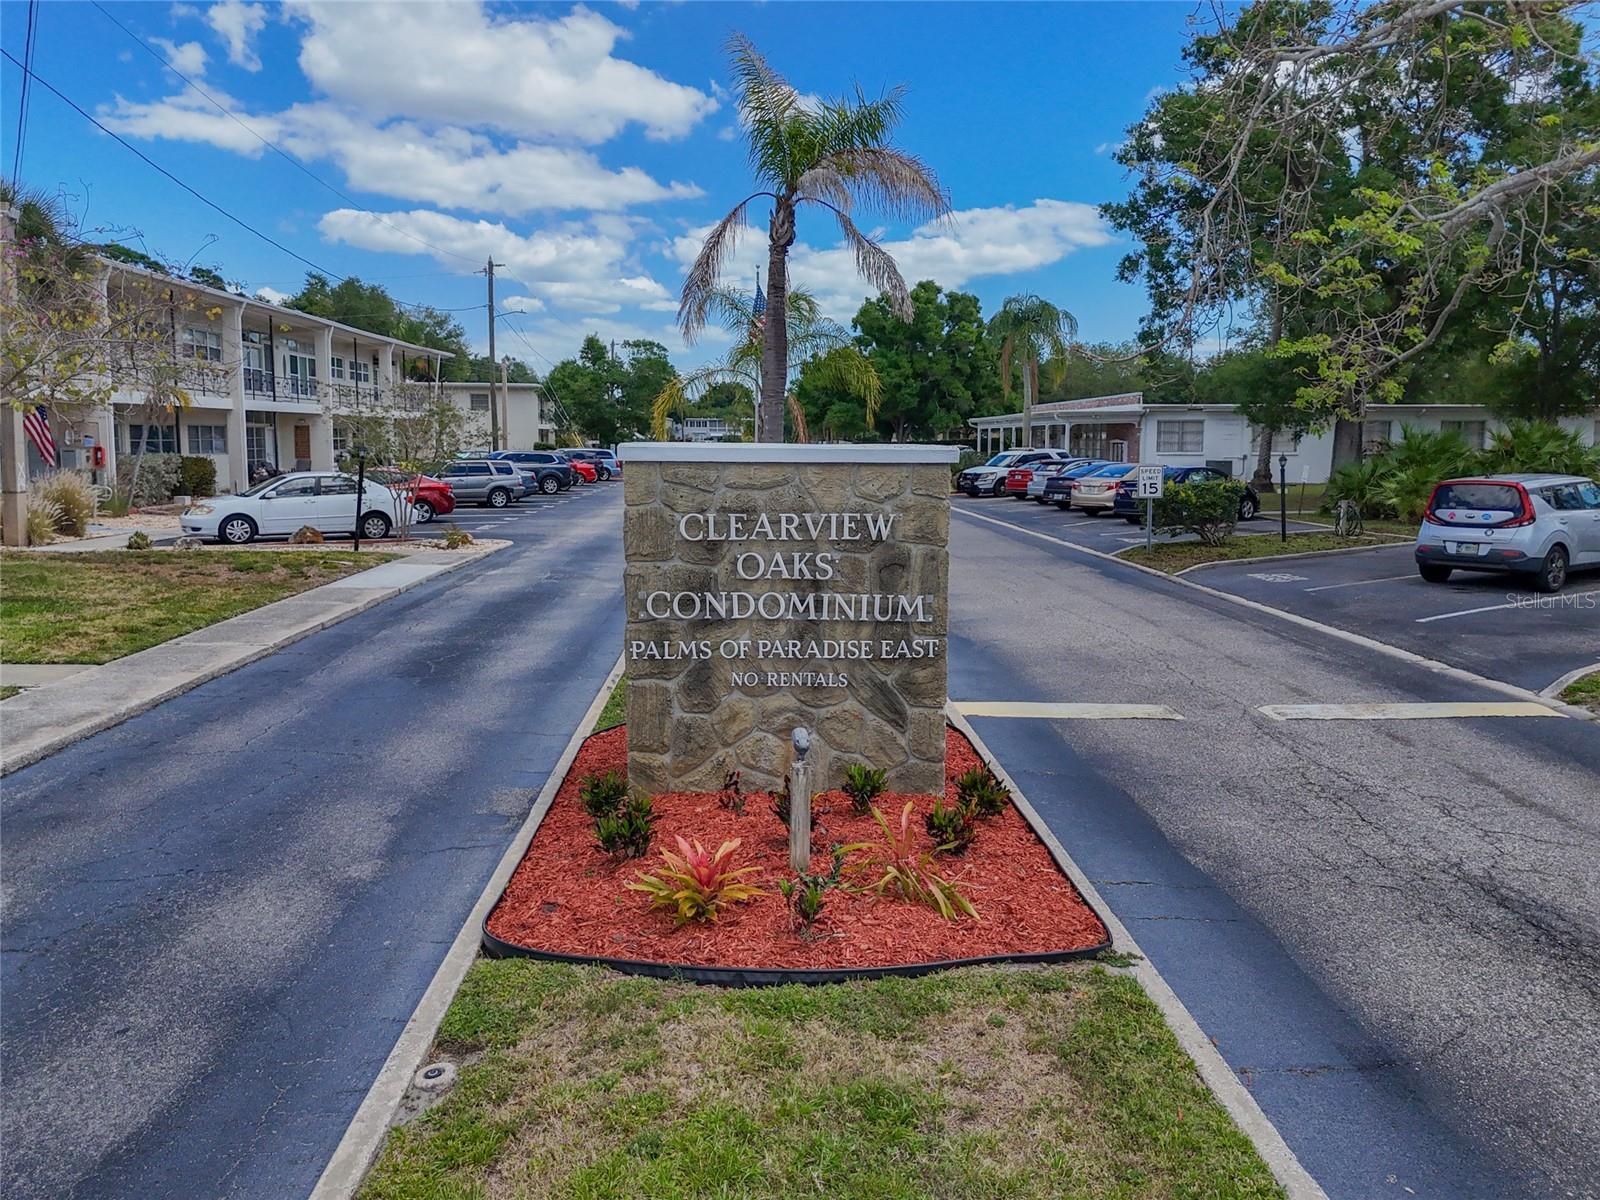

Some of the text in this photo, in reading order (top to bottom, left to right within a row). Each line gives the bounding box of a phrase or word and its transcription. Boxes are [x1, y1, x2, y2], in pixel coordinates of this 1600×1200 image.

[1142, 482, 1159, 495] 15
[679, 513, 895, 542] CLEARVIEW
[736, 552, 834, 581] OAKS
[646, 591, 930, 622] CONDOMINIUM
[631, 639, 939, 660] PALMS OF PARADISE EAST
[731, 672, 848, 688] NO RENTALS
